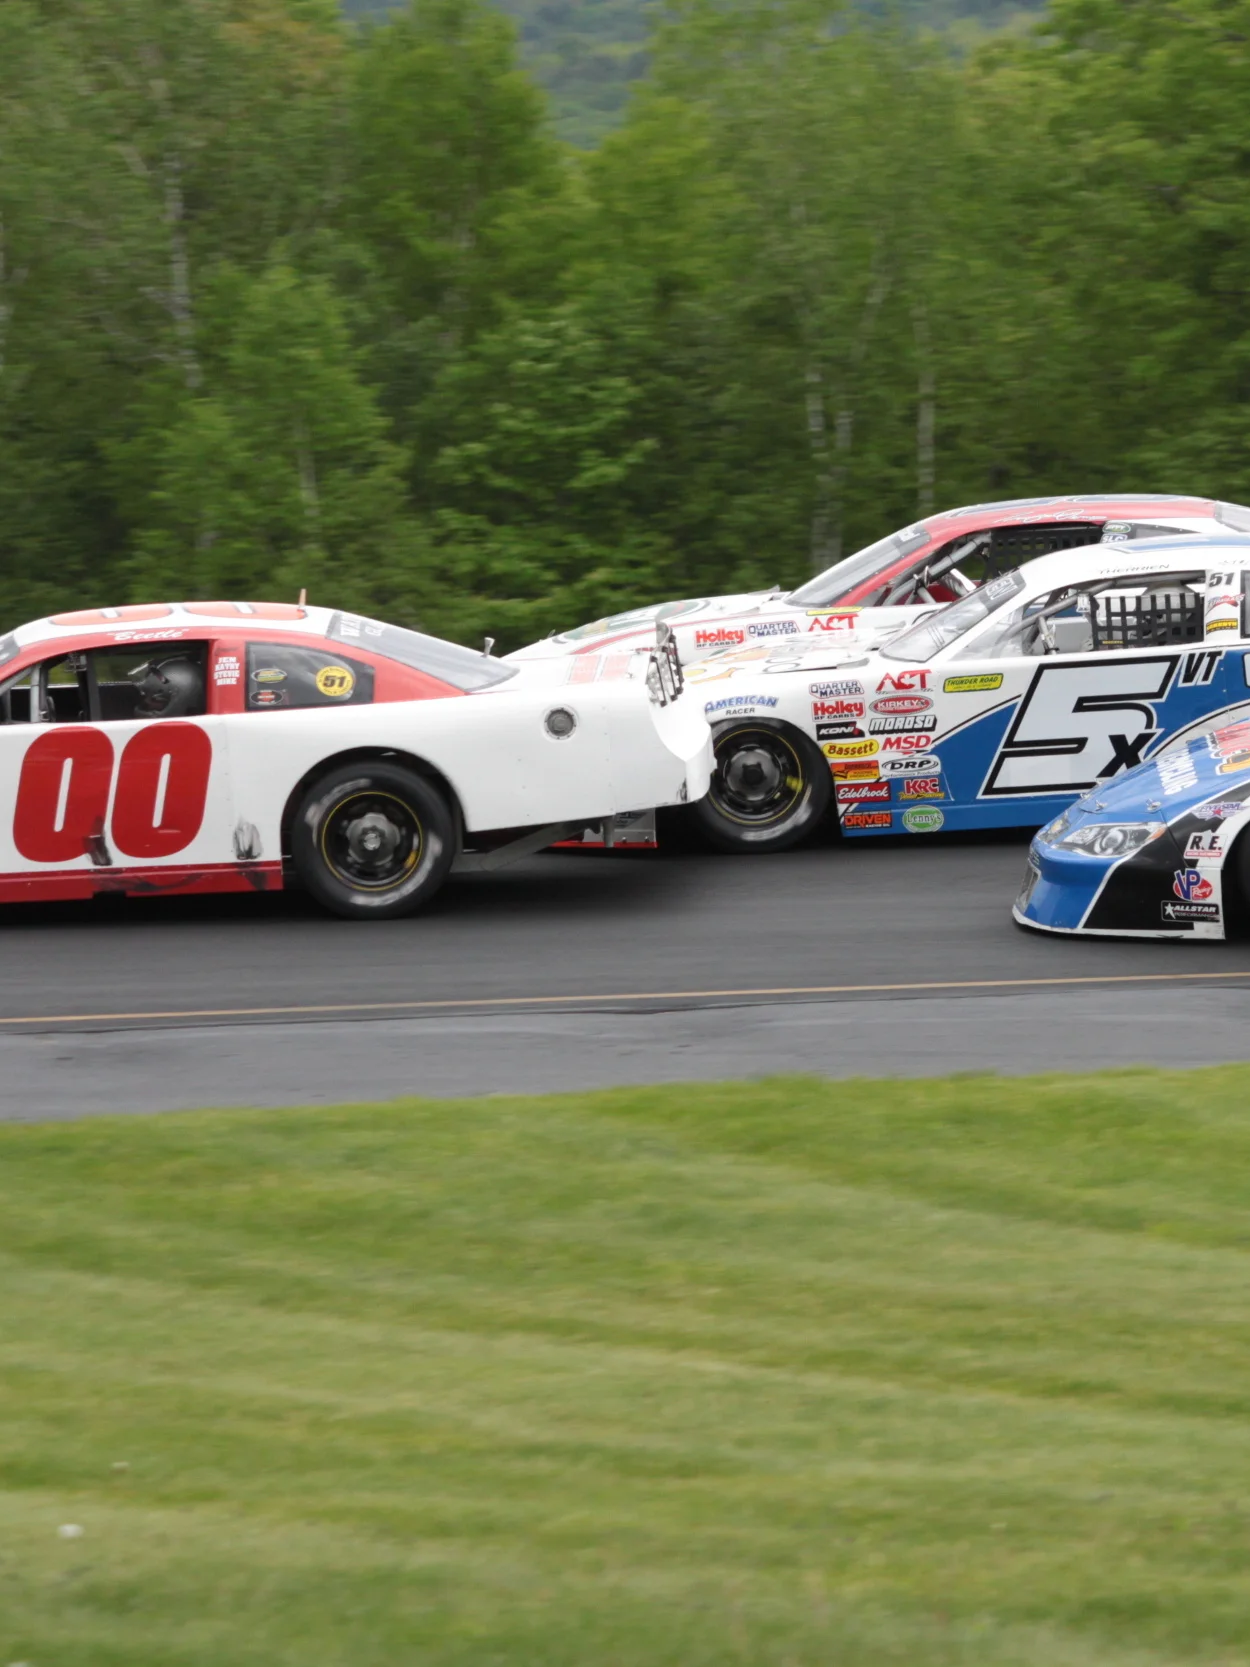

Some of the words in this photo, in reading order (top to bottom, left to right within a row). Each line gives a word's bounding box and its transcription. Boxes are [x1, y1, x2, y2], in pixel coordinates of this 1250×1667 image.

[1209, 572, 1235, 588] 51
[748, 622, 795, 635] QUARTER
[808, 613, 860, 632] ACT
[695, 628, 745, 645] Holley
[757, 628, 798, 637] MASTER
[1180, 651, 1223, 685] VT
[323, 675, 347, 688] 51
[811, 681, 858, 694] QUARTER
[875, 669, 933, 692] ACT
[947, 678, 979, 687] THUNDER
[979, 676, 999, 684] ROAD
[820, 687, 864, 698] MASTER
[704, 695, 780, 713] AMERICAN
[725, 707, 756, 716] RACER
[813, 700, 865, 717] Holley
[876, 699, 919, 709] KIRKEY
[819, 726, 854, 737] KONI
[869, 716, 937, 734] MOROSO
[827, 741, 874, 756] Bassett
[881, 735, 933, 751] MSD
[889, 757, 928, 771] DRP
[12, 720, 213, 863] 00
[837, 784, 889, 800] Edelbrock
[904, 778, 939, 795] KRC
[844, 813, 892, 828] DRIVEN
[906, 813, 942, 825] Lenny's
[1174, 869, 1201, 900] VP
[1172, 904, 1217, 913] ALLSTAR
